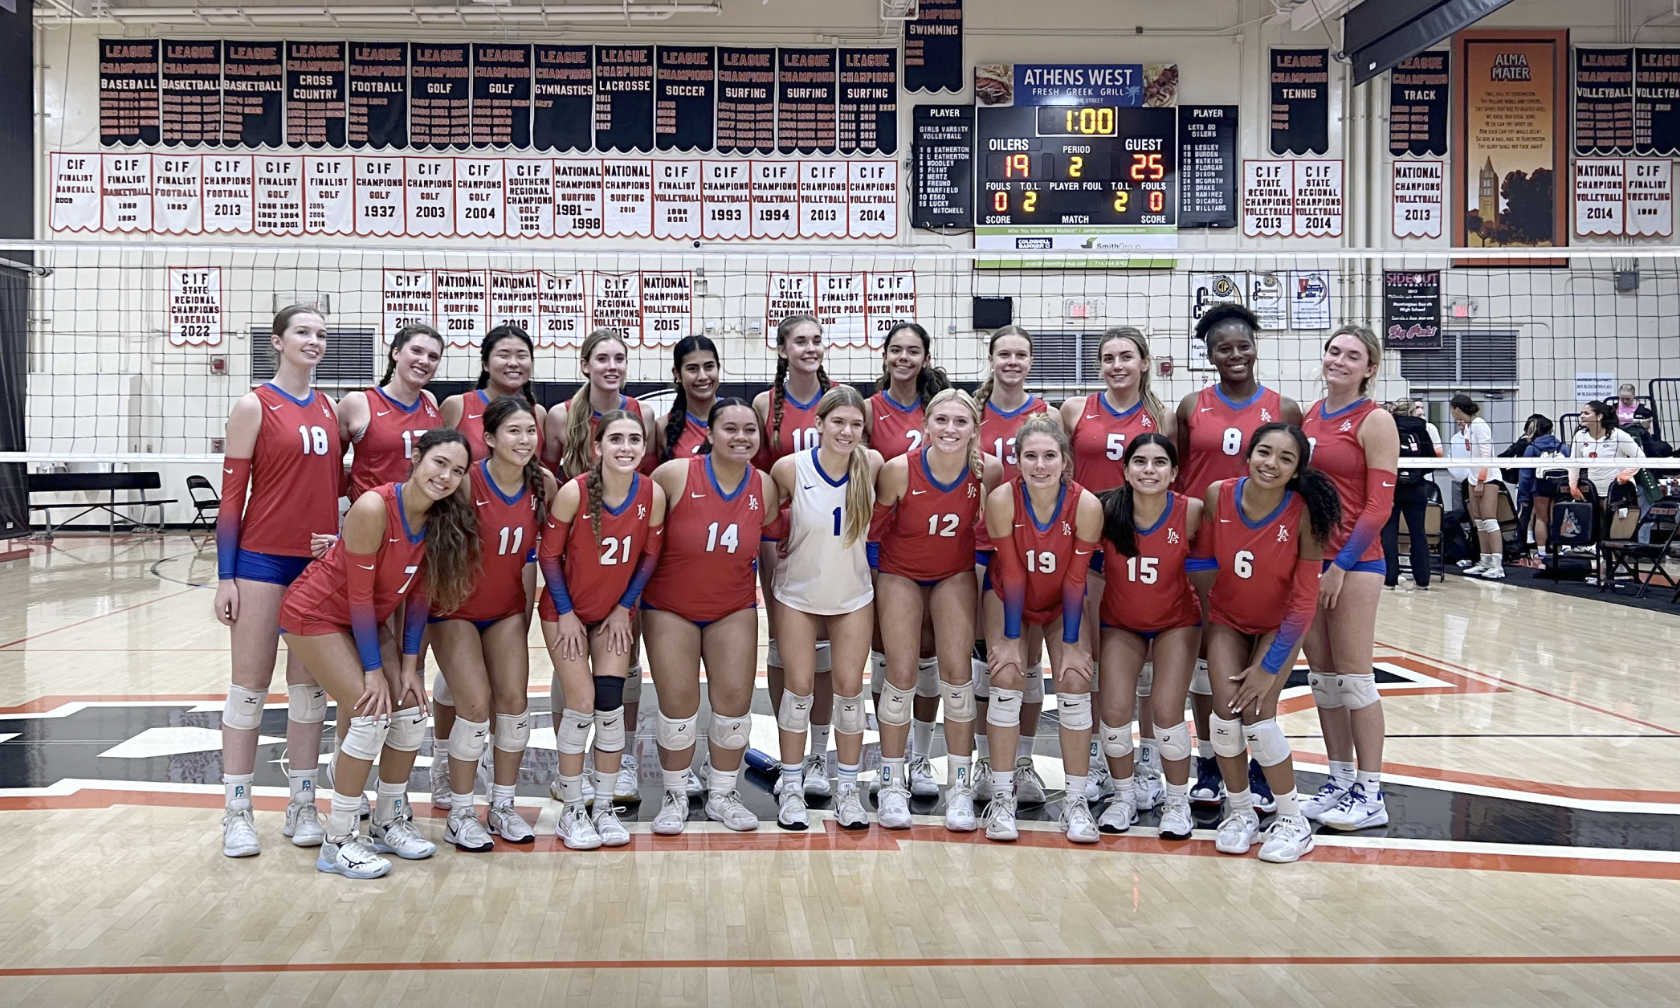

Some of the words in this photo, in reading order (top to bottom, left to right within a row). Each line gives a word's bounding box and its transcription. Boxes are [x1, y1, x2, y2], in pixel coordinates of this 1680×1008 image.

[602, 50, 647, 62] LEAGUE
[846, 54, 889, 66] LEAGUE
[1495, 54, 1526, 66] ALMA
[597, 66, 652, 77] CHAMPIONS
[1492, 68, 1530, 79] MATER
[300, 76, 333, 85] CROSS
[1025, 70, 1083, 85] ATHENS
[1089, 70, 1132, 85] WEST
[101, 79, 157, 89] BASEBALL
[162, 80, 220, 90] BASKETBALL
[224, 81, 282, 91] BASKETBALL
[352, 82, 403, 92] FOOTBALL
[428, 84, 452, 94] GOLF
[489, 84, 514, 94] GOLF
[599, 81, 650, 91] LACROSSE
[293, 89, 337, 99] COUNTRY
[535, 85, 593, 95] GYMNASTICS
[666, 86, 705, 96] SOCCER
[726, 88, 766, 98] SURFING
[787, 88, 827, 98] SURFING
[848, 88, 888, 98] SURFING
[1067, 88, 1093, 96] GREEK
[1101, 88, 1124, 96] GRILL
[1283, 89, 1316, 98] TENNIS
[1577, 88, 1632, 98] VOLLEYBALL
[1404, 91, 1436, 100] TRACK
[930, 109, 959, 117] PLAYER
[1067, 109, 1112, 133] 1:00
[989, 139, 1029, 150] OILERS
[1125, 139, 1162, 150] GUEST
[555, 166, 601, 176] NATIONAL
[605, 166, 650, 177] NATIONAL
[1006, 155, 1028, 178] 19
[1069, 157, 1083, 177] 2
[1131, 155, 1163, 179] 25
[1578, 166, 1622, 176] NATIONAL
[1396, 168, 1440, 178] NATIONAL
[370, 191, 390, 199] GOLF
[421, 192, 439, 200] GOLF
[510, 187, 549, 195] REGIONAL
[995, 192, 1007, 211] 0
[1023, 192, 1036, 211] 2
[1115, 192, 1128, 211] 2
[1150, 192, 1162, 211] 0
[215, 205, 240, 215] 2013
[365, 206, 395, 217] 1937
[416, 207, 445, 217] 2003
[465, 208, 495, 218] 2004
[519, 206, 540, 214] GOLF
[556, 205, 582, 215] 1981
[711, 210, 741, 220] 1993
[760, 210, 790, 220] 1994
[811, 210, 836, 220] 2013
[1405, 210, 1430, 220] 2013
[1587, 208, 1613, 218] 2014
[860, 210, 885, 221] 2014
[1141, 216, 1166, 224] SCORE
[572, 218, 600, 229] 1998
[1256, 218, 1281, 228] 2013
[1306, 218, 1331, 228] 2014
[438, 276, 484, 287] NATIONAL
[493, 277, 536, 288] NATIONAL
[644, 278, 689, 288] NATIONAL
[175, 296, 215, 304] REGIONAL
[597, 300, 636, 308] REGIONAL
[387, 303, 429, 311] BASEBALL
[444, 304, 478, 312] SURFING
[498, 305, 532, 313] SURFING
[895, 305, 914, 313] POLO
[448, 319, 474, 330] 2016
[548, 320, 574, 330] 2015
[654, 320, 679, 330] 2015
[181, 326, 209, 336] 2022
[299, 425, 329, 455] 18
[792, 428, 819, 451] 10
[906, 430, 922, 450] 2
[1222, 427, 1242, 456] 8
[1106, 433, 1126, 461] 5
[832, 507, 841, 536] 1
[928, 514, 960, 536] 12
[498, 527, 523, 555] 11
[706, 522, 739, 553] 14
[600, 536, 631, 565] 21
[1026, 550, 1056, 574] 19
[1233, 550, 1254, 579] 6
[1127, 557, 1159, 584] 15
[397, 566, 417, 594] 7
